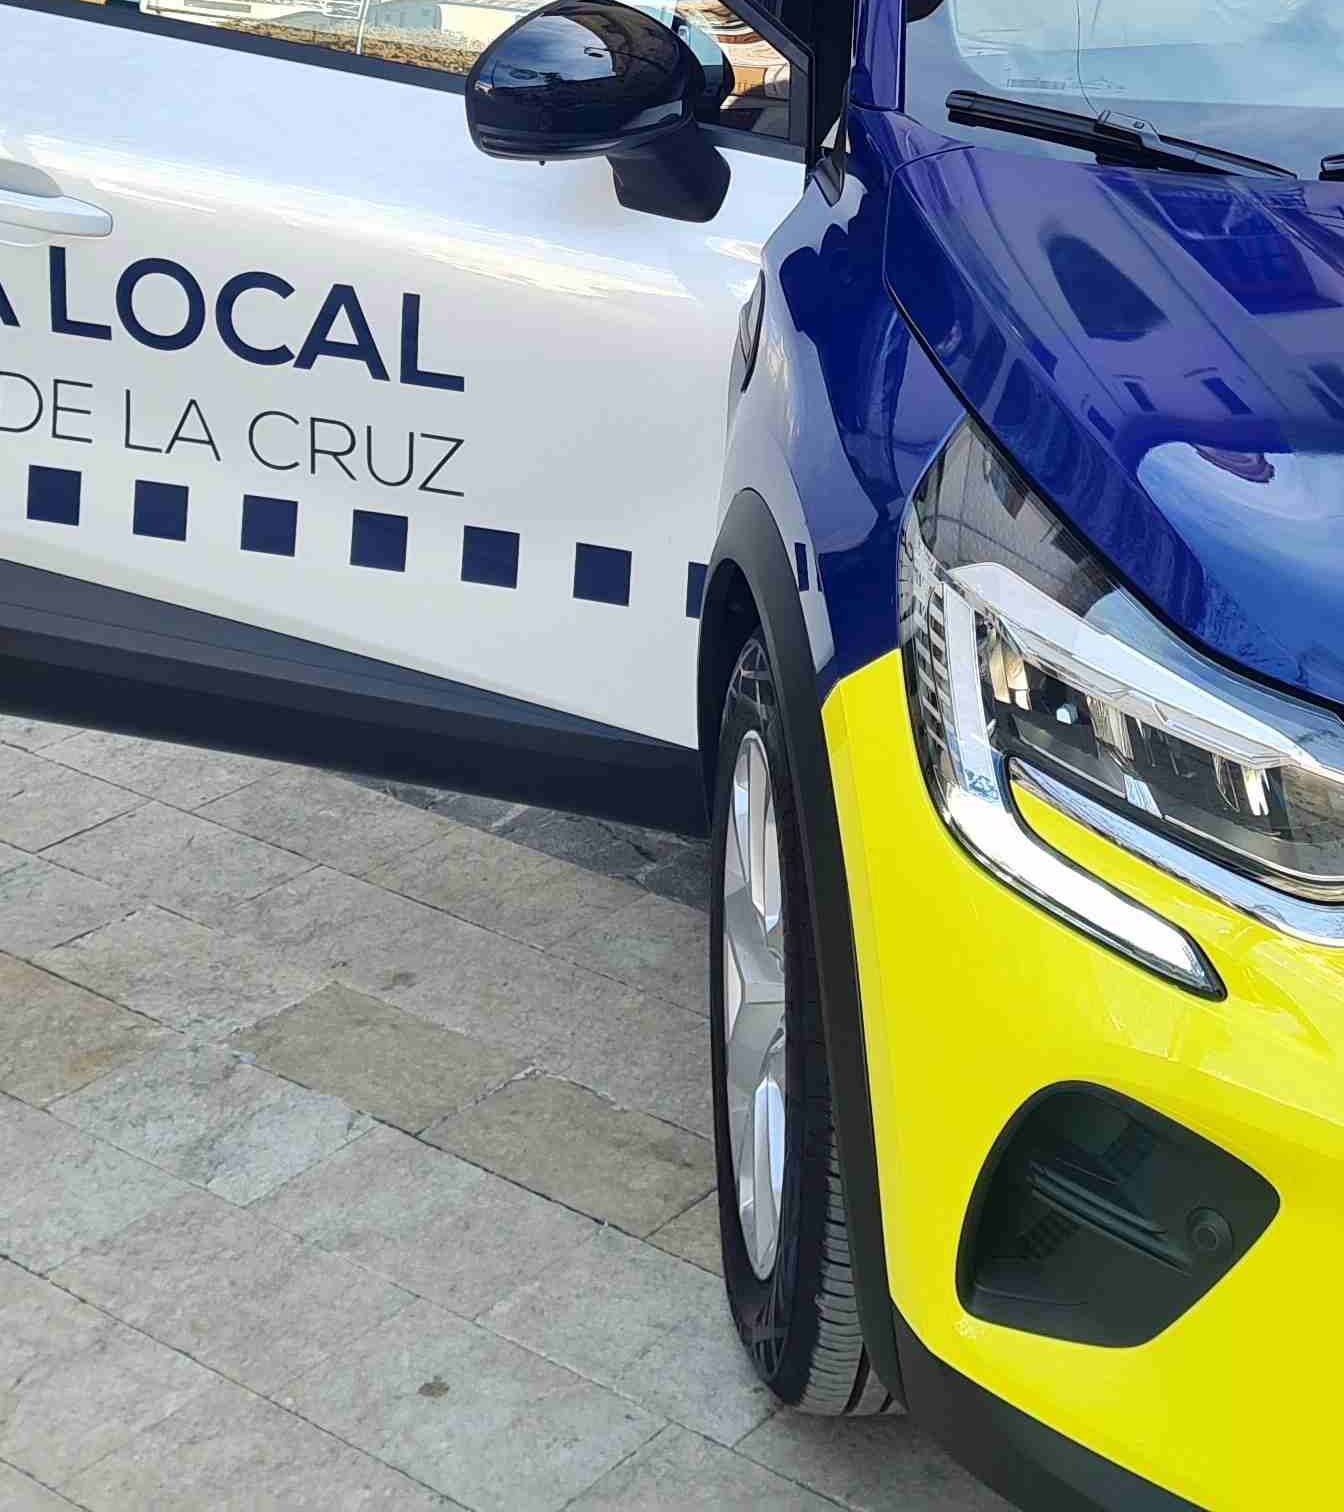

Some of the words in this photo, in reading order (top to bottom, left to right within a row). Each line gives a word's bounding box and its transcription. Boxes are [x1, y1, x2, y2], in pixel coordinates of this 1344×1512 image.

[48, 244, 465, 393] LOCAL
[123, 388, 222, 462] LA
[247, 409, 466, 498] CRUZ
